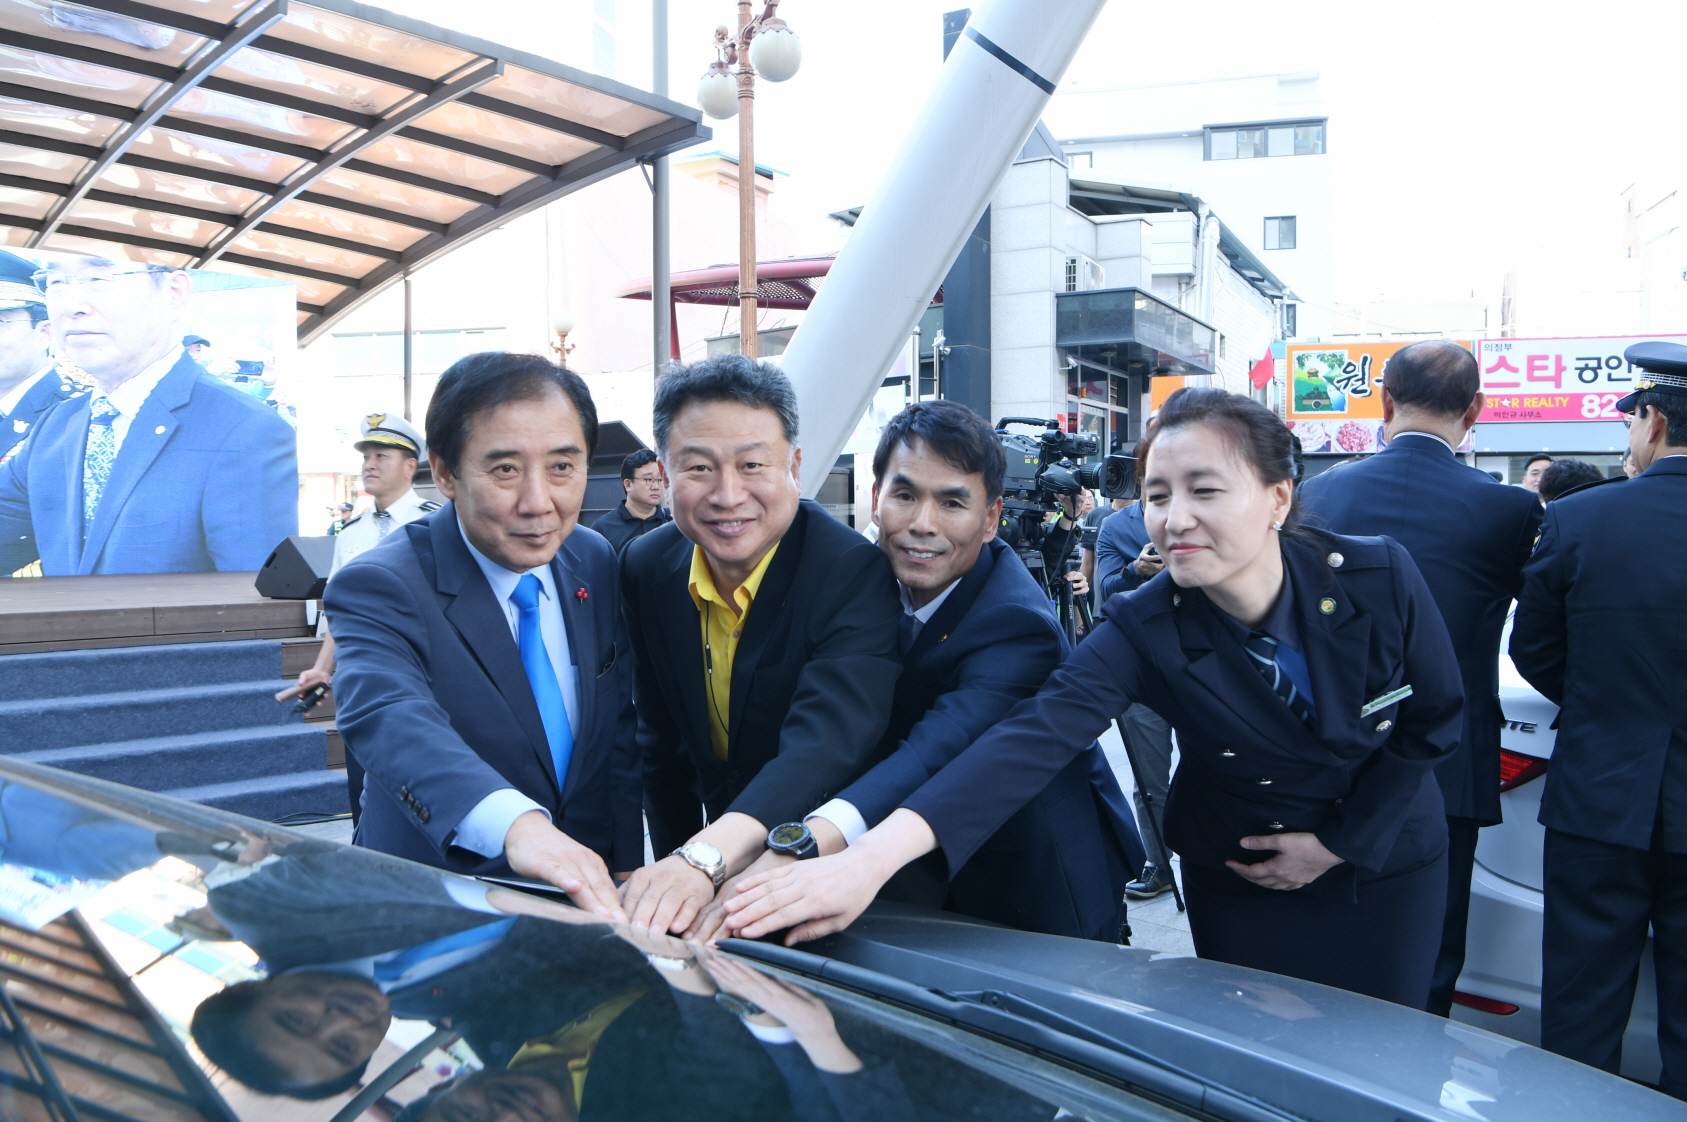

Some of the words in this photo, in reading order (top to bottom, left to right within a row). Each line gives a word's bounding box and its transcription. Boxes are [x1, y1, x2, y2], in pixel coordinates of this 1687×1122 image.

[1484, 343, 1513, 352] 의정부
[1334, 353, 1386, 397] 원
[1483, 354, 1567, 389] 스타
[1574, 355, 1636, 384] 공인
[1523, 396, 1570, 408] REALTY
[1581, 394, 1620, 418] 82
